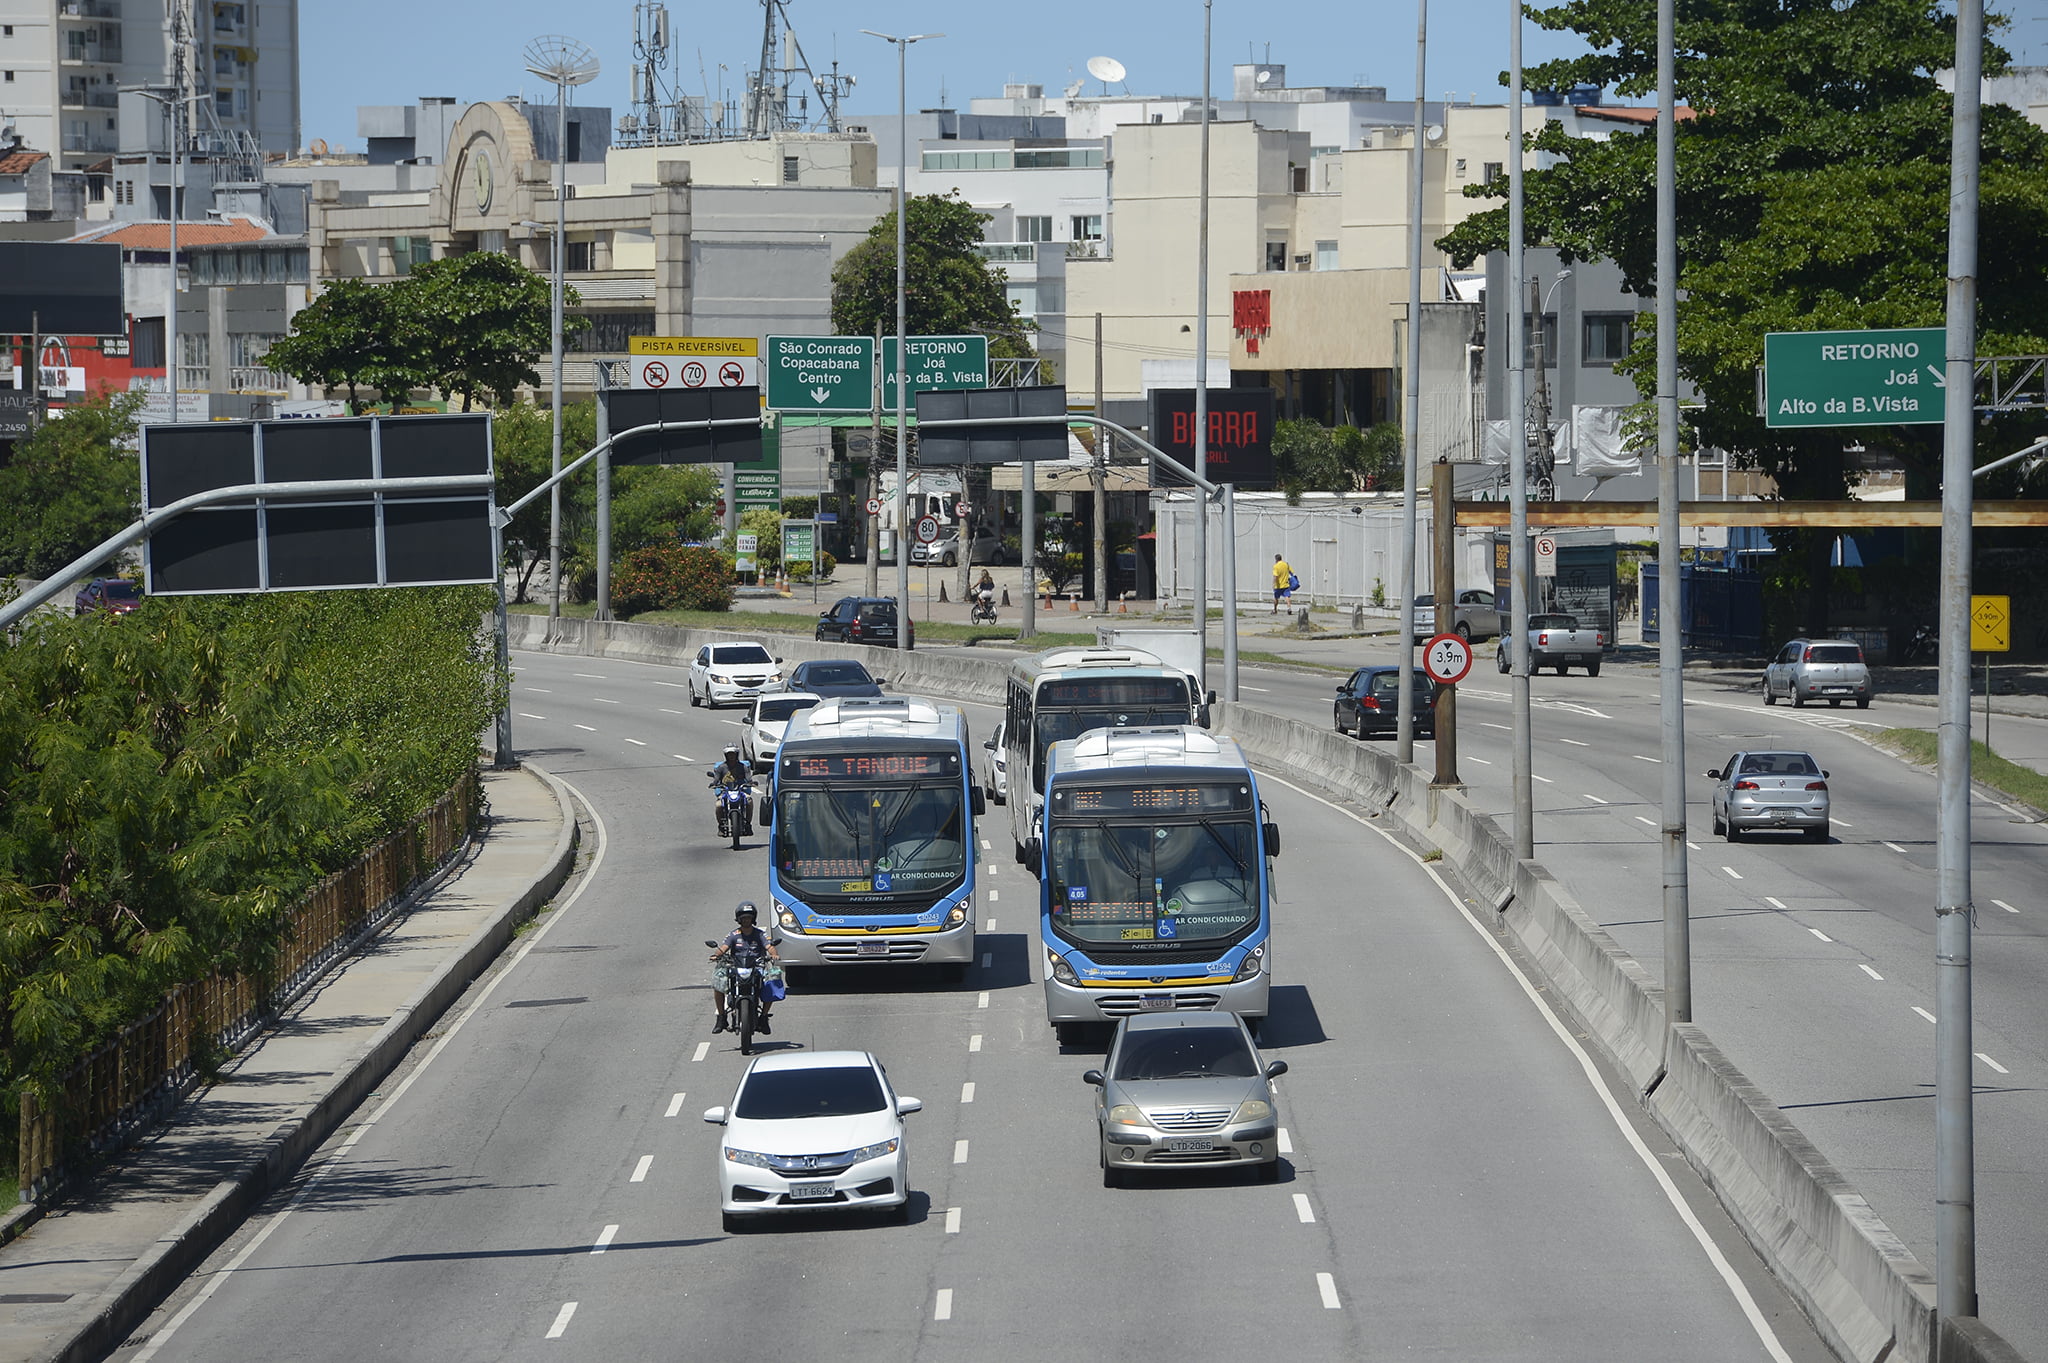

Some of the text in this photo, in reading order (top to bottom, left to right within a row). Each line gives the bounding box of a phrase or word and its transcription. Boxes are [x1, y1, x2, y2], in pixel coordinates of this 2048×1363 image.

[642, 341, 746, 352] PISTA REVERSÍVEL
[779, 342, 862, 355] São Conrado
[904, 342, 967, 354] RETORNO
[1821, 343, 1920, 361] RETORNO
[781, 357, 860, 370] Copacabana
[923, 357, 946, 369] Joá
[687, 367, 702, 379] 70
[798, 372, 842, 384] Centro
[916, 371, 931, 383] da
[935, 371, 948, 383] B.
[953, 371, 984, 383] Vista
[1884, 368, 1919, 386] Joá
[1778, 398, 1817, 414] Alto
[1823, 398, 1847, 414] da
[0, 423, 27, 432] .2450
[921, 521, 934, 533] 80
[800, 759, 829, 776] 565
[902, 871, 956, 880] CONDICIONADO
[1175, 915, 1247, 925] AR CONDICIONADO
